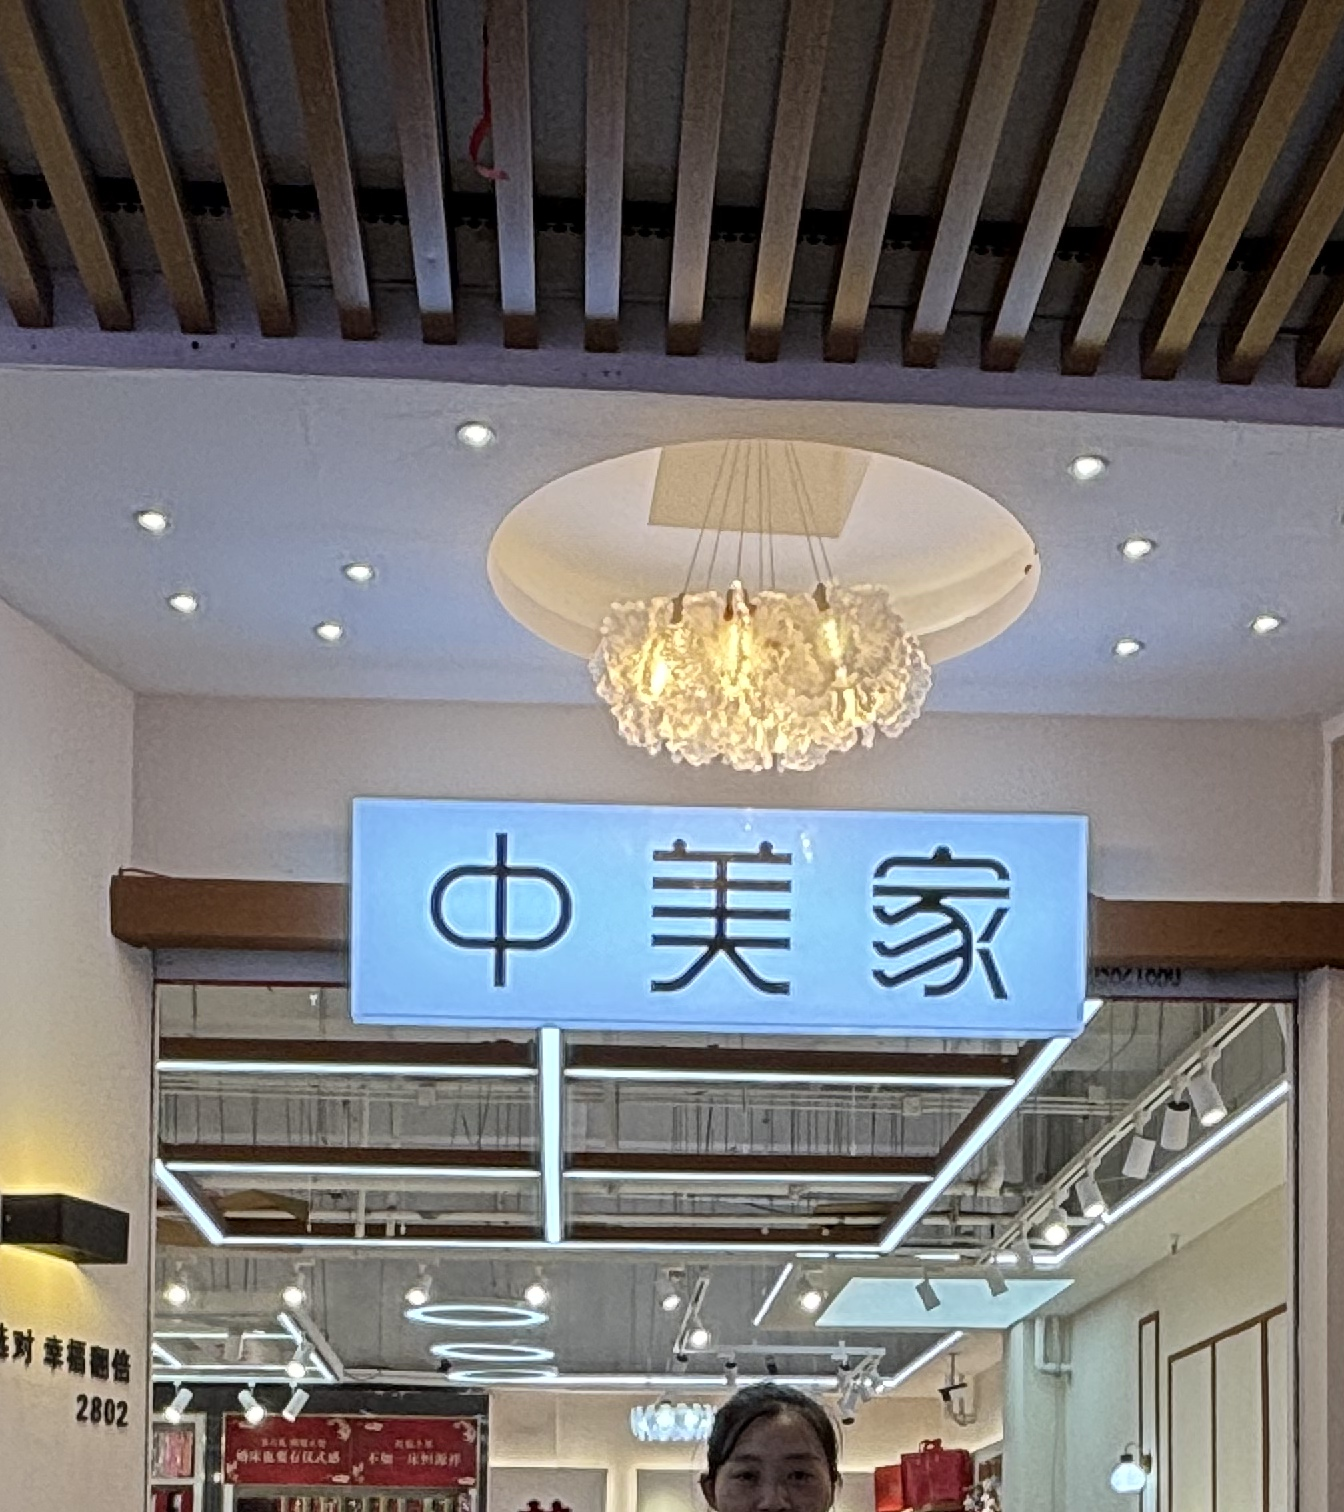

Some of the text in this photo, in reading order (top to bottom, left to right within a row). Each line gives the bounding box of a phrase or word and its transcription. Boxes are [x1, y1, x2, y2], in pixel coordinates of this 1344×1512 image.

[430, 832, 1012, 1000] 中美家
[76, 1393, 129, 1428] 2802
